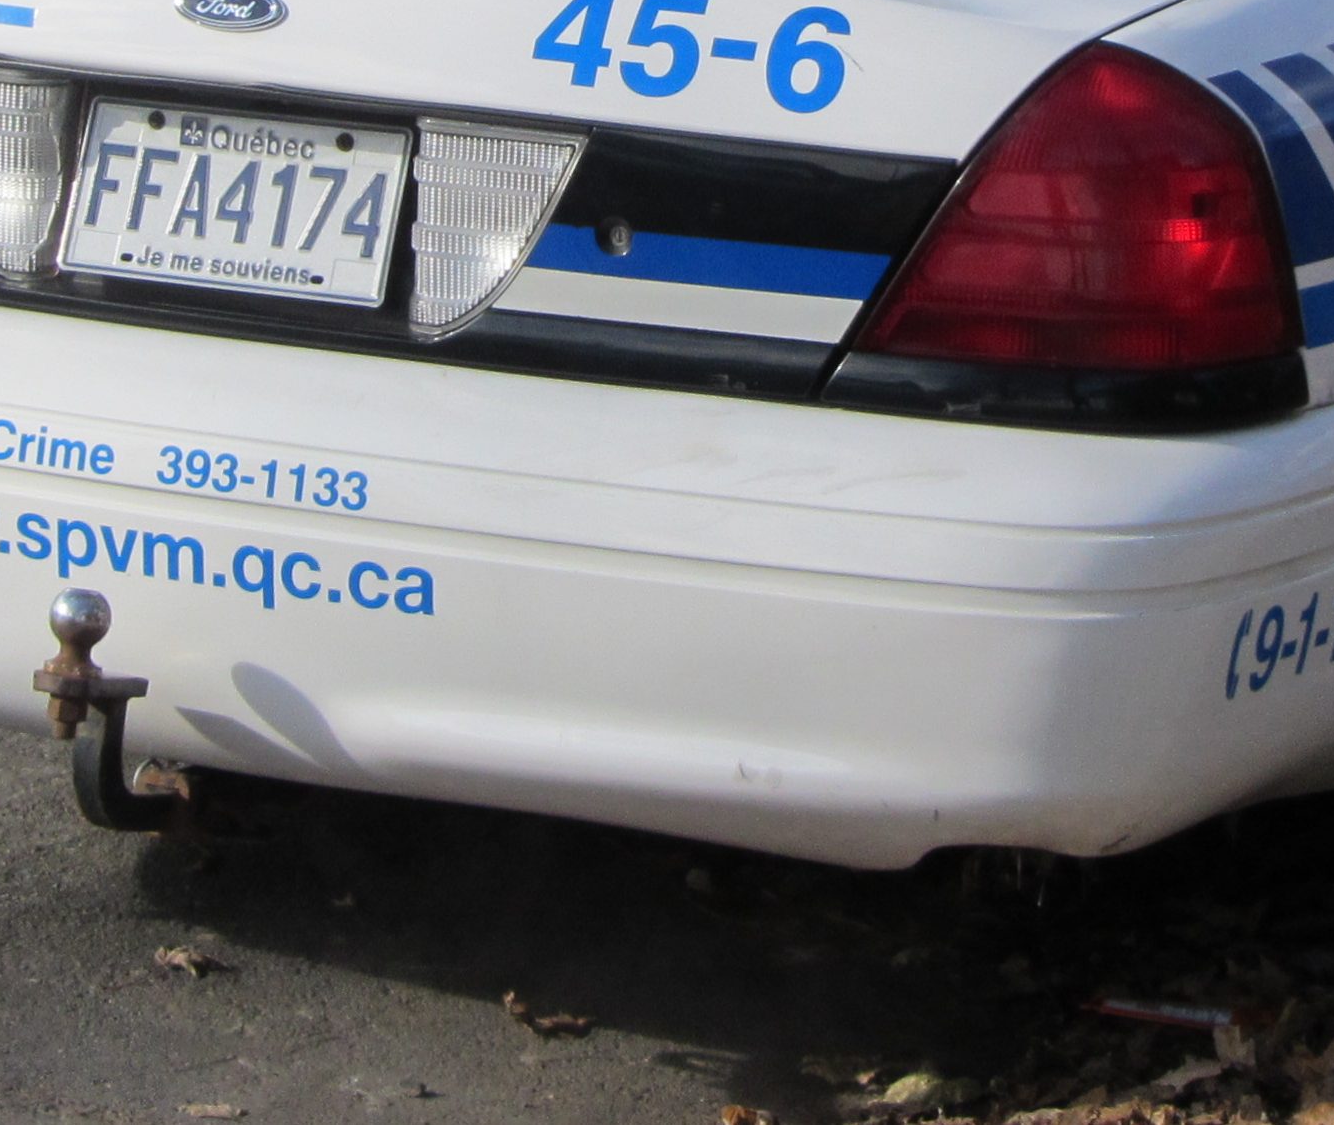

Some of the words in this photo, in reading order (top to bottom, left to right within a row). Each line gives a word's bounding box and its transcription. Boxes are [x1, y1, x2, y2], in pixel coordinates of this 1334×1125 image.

[210, 124, 316, 160] Québec
[83, 142, 388, 259] FFA4174
[136, 245, 163, 269] Je
[169, 251, 203, 272] me
[208, 257, 312, 286] souviens
[156, 445, 370, 512] 393-1133
